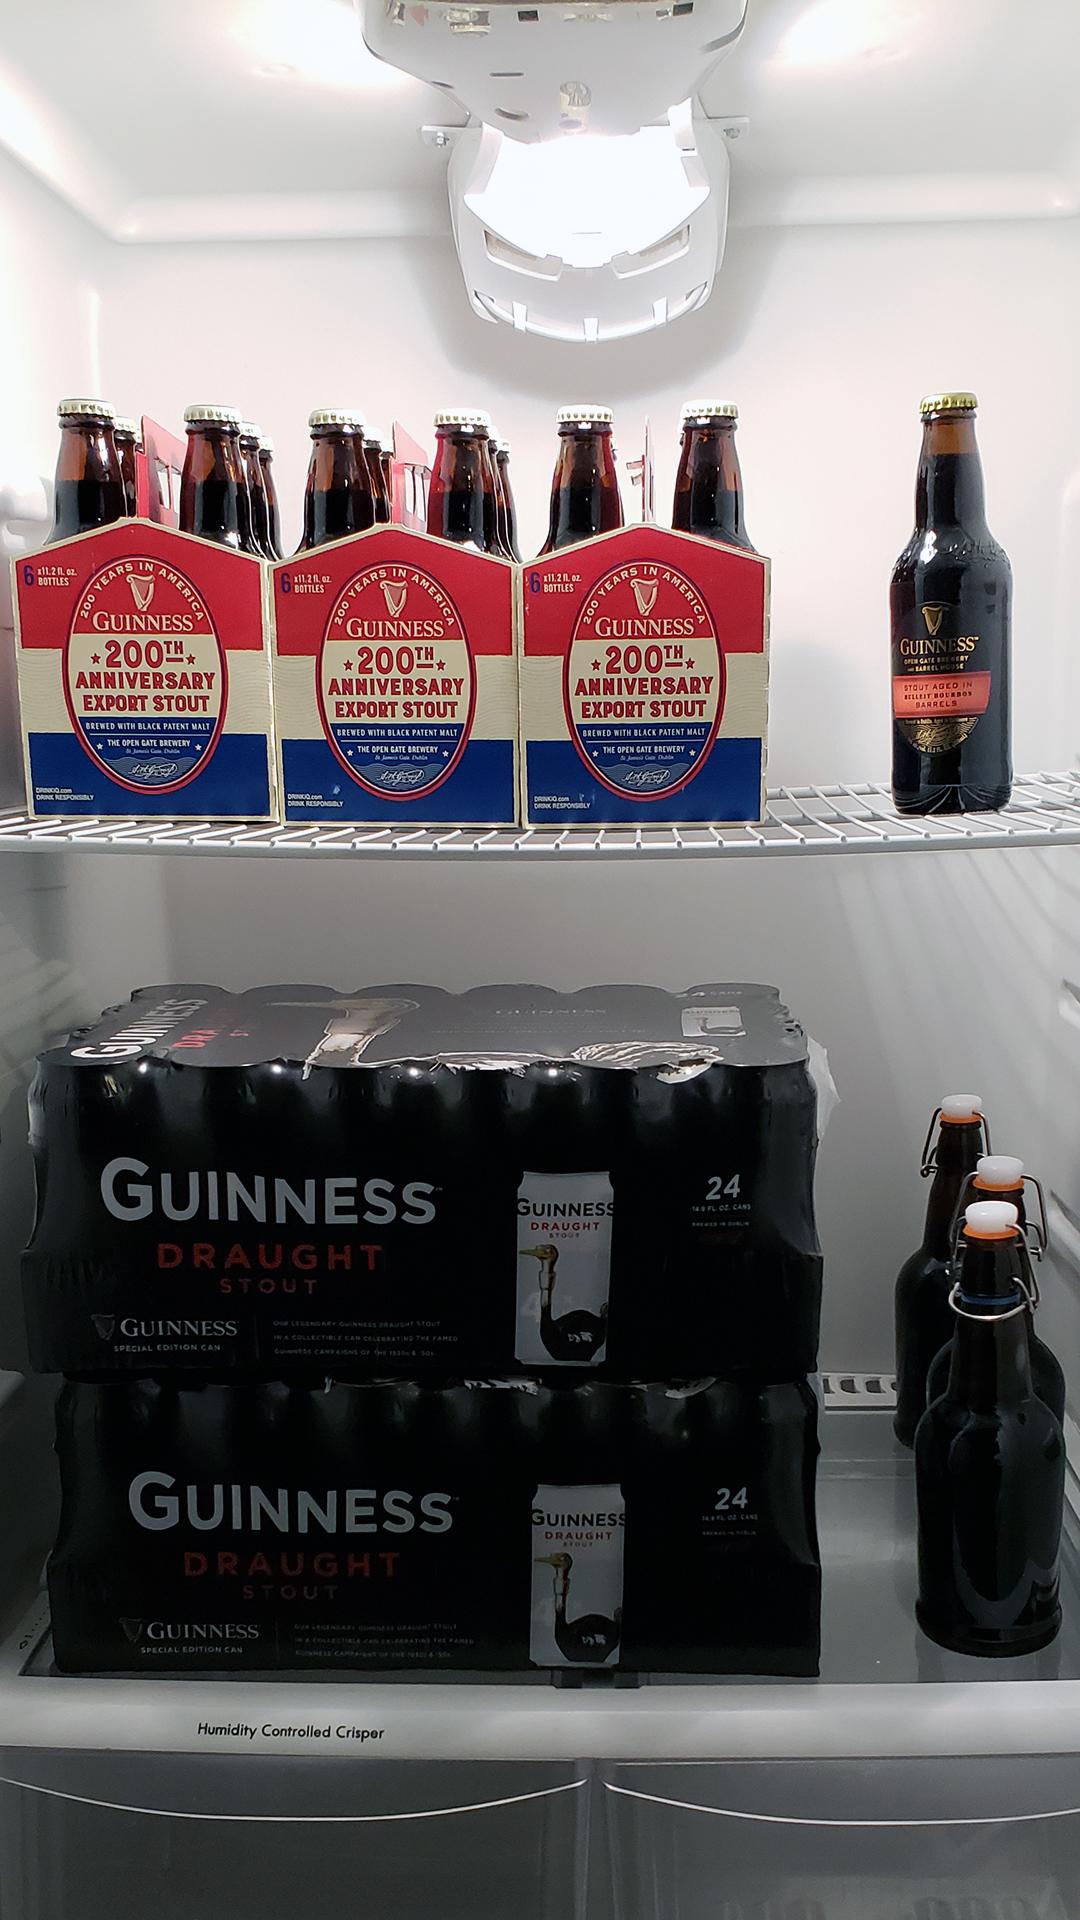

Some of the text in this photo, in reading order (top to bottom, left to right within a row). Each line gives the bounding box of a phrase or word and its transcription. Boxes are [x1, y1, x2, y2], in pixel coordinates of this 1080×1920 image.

[23, 565, 34, 586] 6
[38, 577, 69, 586] BOTTLES
[281, 572, 291, 593] 6
[530, 572, 541, 593] 6
[80, 562, 204, 621] 200 YEARS IN AMERICA
[294, 584, 325, 593] BOTTLES
[334, 568, 455, 626] 200 YEARS IN AMERICA
[543, 584, 574, 593] BOTTLES
[583, 566, 705, 625] 200 YEARS IN AMERICA
[93, 611, 193, 631] GUINNESS
[346, 617, 444, 638] GUINNESS
[595, 616, 694, 637] GUINNESS
[900, 636, 975, 655] GUINNESS
[75, 671, 215, 690] ANNIVERSARY
[328, 678, 464, 696] ANNIVERSARY
[575, 676, 713, 696] ANNIVERSARY
[904, 684, 928, 692] STOUT
[933, 682, 959, 690] AGED
[83, 695, 210, 712] EXPORT STOUT
[335, 701, 458, 718] EXPORT STOUT
[581, 700, 707, 718] EXPORT STOUT
[916, 700, 957, 708] BARRELS
[86, 722, 210, 731] BREWED WITH BLACK PATENT MALT
[337, 728, 458, 737] BREWED WITH BLACK PATENT MALT
[583, 728, 706, 737] BREWED WITH BLACK PATENT MALT
[107, 739, 190, 747] THE OPEN GATE BREWERY
[603, 746, 616, 754] THE
[617, 746, 635, 754] OPEN
[654, 745, 685, 753] BREWERY
[71, 999, 208, 1058] GUINNESS
[100, 1157, 436, 1225] GUINNESS
[705, 1173, 740, 1200] 24
[517, 1198, 615, 1217] GUINNESS
[531, 1222, 600, 1231] DRAUGHT
[157, 1243, 383, 1271] DRAUGHT
[219, 1278, 318, 1294] STOUT
[120, 1318, 238, 1337] GUINNESS
[114, 1345, 153, 1353] SPECIAL
[128, 1471, 453, 1533] GUINNESS
[715, 1486, 748, 1510] 24
[531, 1509, 626, 1527] GUINNESS
[545, 1532, 612, 1540] DRAUGHT
[183, 1551, 399, 1577] DRAUGHT
[242, 1585, 338, 1600] STOUT
[147, 1622, 259, 1639] GUINNESS
[198, 1722, 385, 1742] Humidity Controlled Crisper
